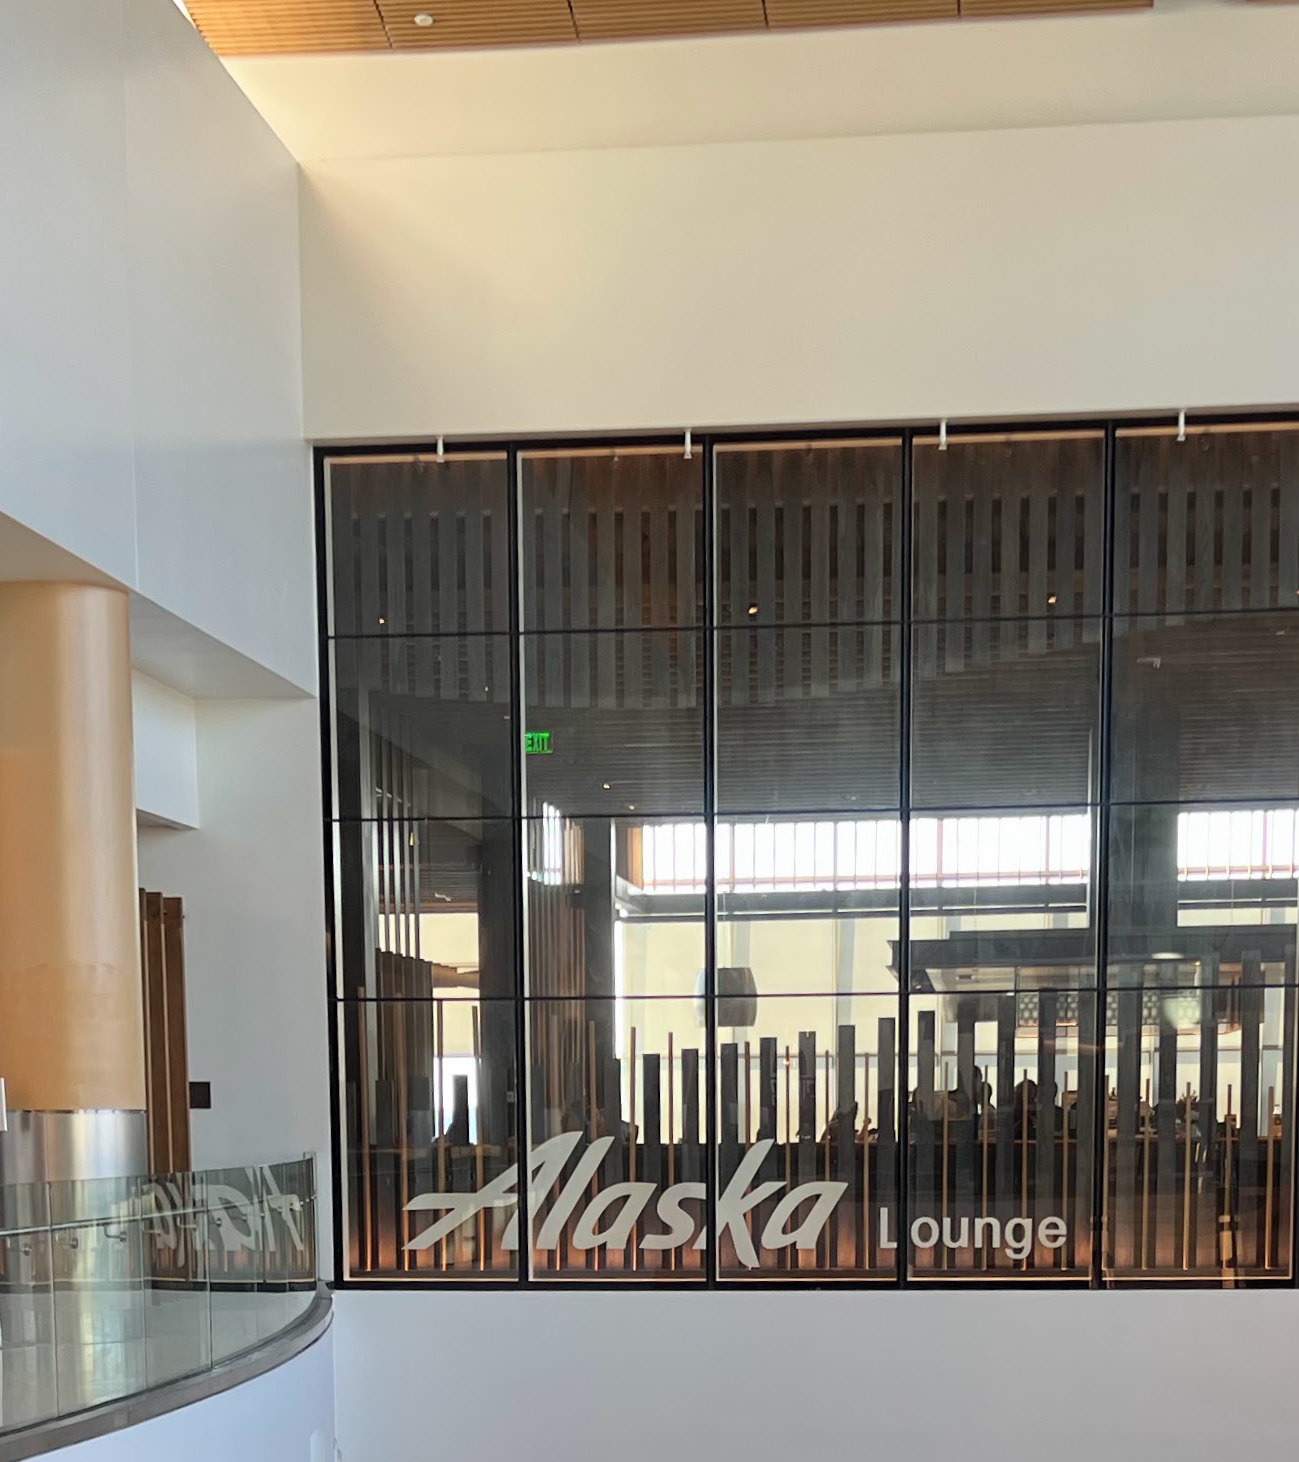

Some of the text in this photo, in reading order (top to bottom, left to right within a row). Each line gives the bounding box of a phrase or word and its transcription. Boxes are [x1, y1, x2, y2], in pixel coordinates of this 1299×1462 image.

[525, 732, 550, 751] EXIT
[401, 1131, 1067, 1268] Alaska Lounge
